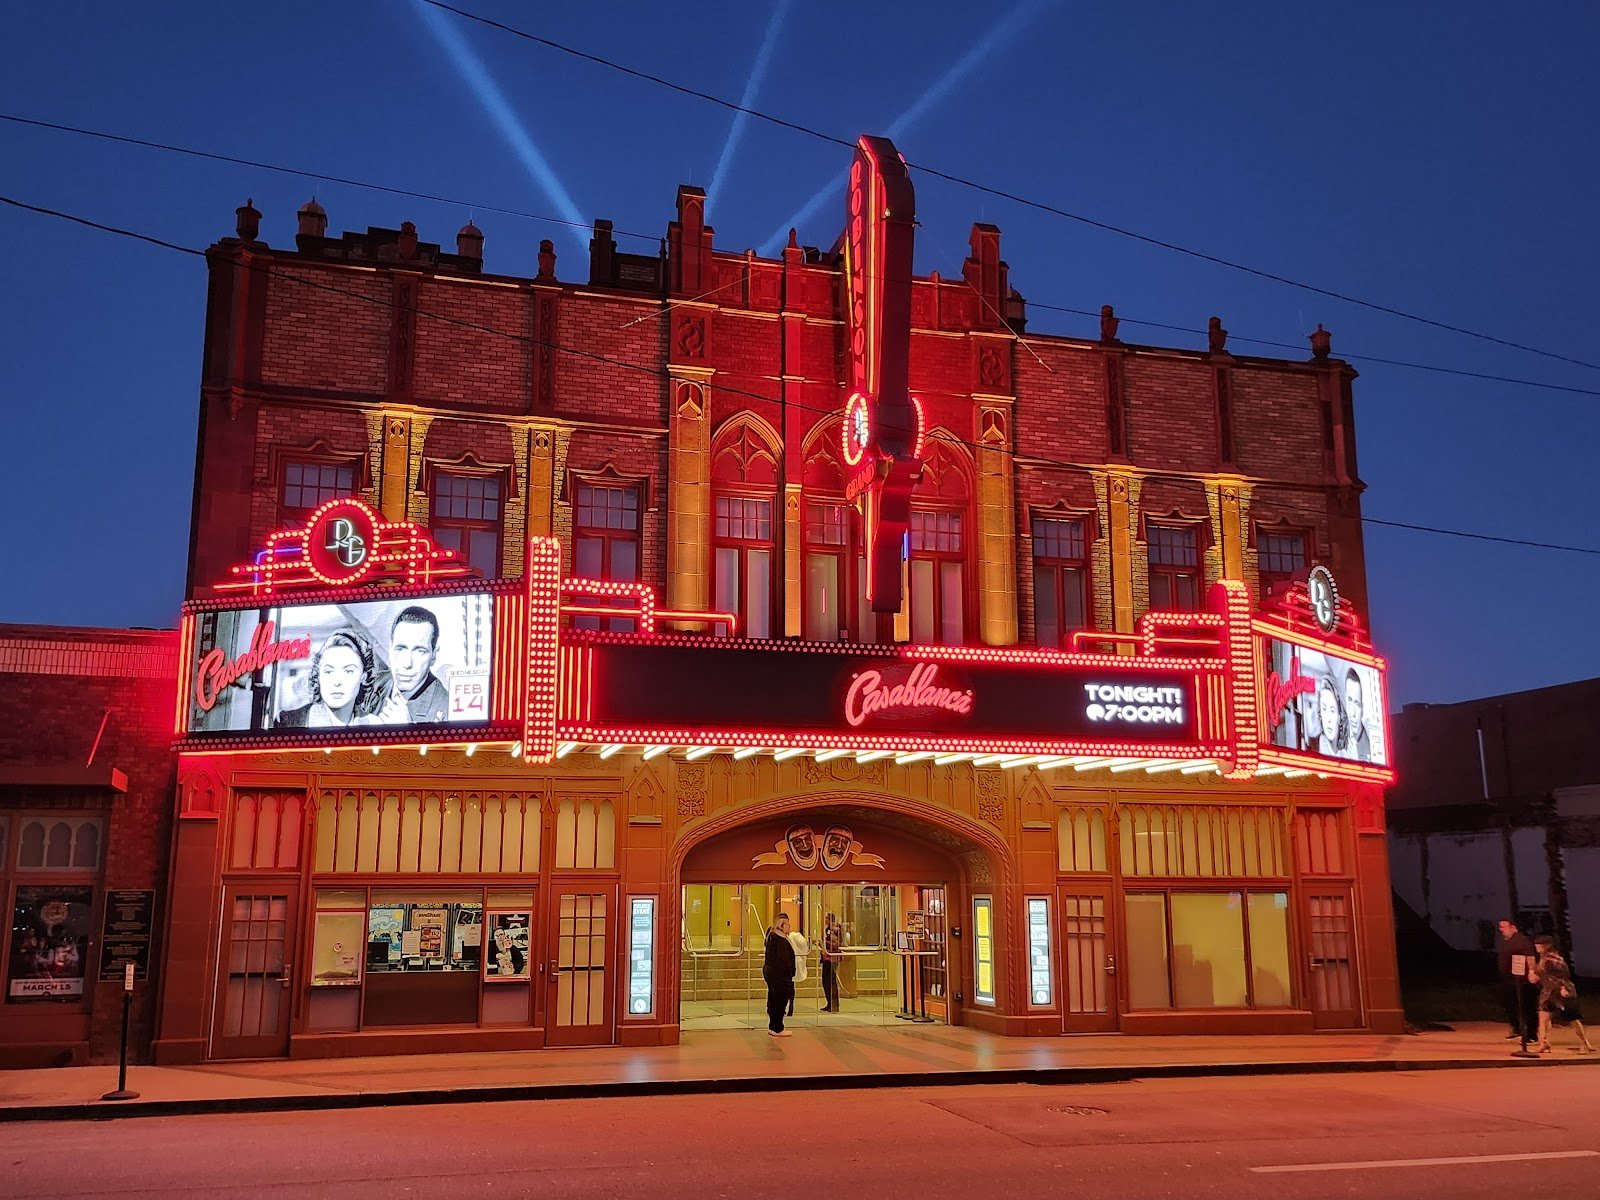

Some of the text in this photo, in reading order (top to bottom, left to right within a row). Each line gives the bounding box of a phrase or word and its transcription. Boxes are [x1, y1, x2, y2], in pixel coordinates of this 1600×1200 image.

[851, 160, 866, 387] ROBINSON
[846, 463, 875, 501] GRAND
[197, 620, 312, 711] Casablanca
[452, 695, 484, 713] 14
[454, 683, 482, 695] FEB
[845, 662, 973, 727] Casablanca
[1084, 684, 1182, 704] TONIGHT!
